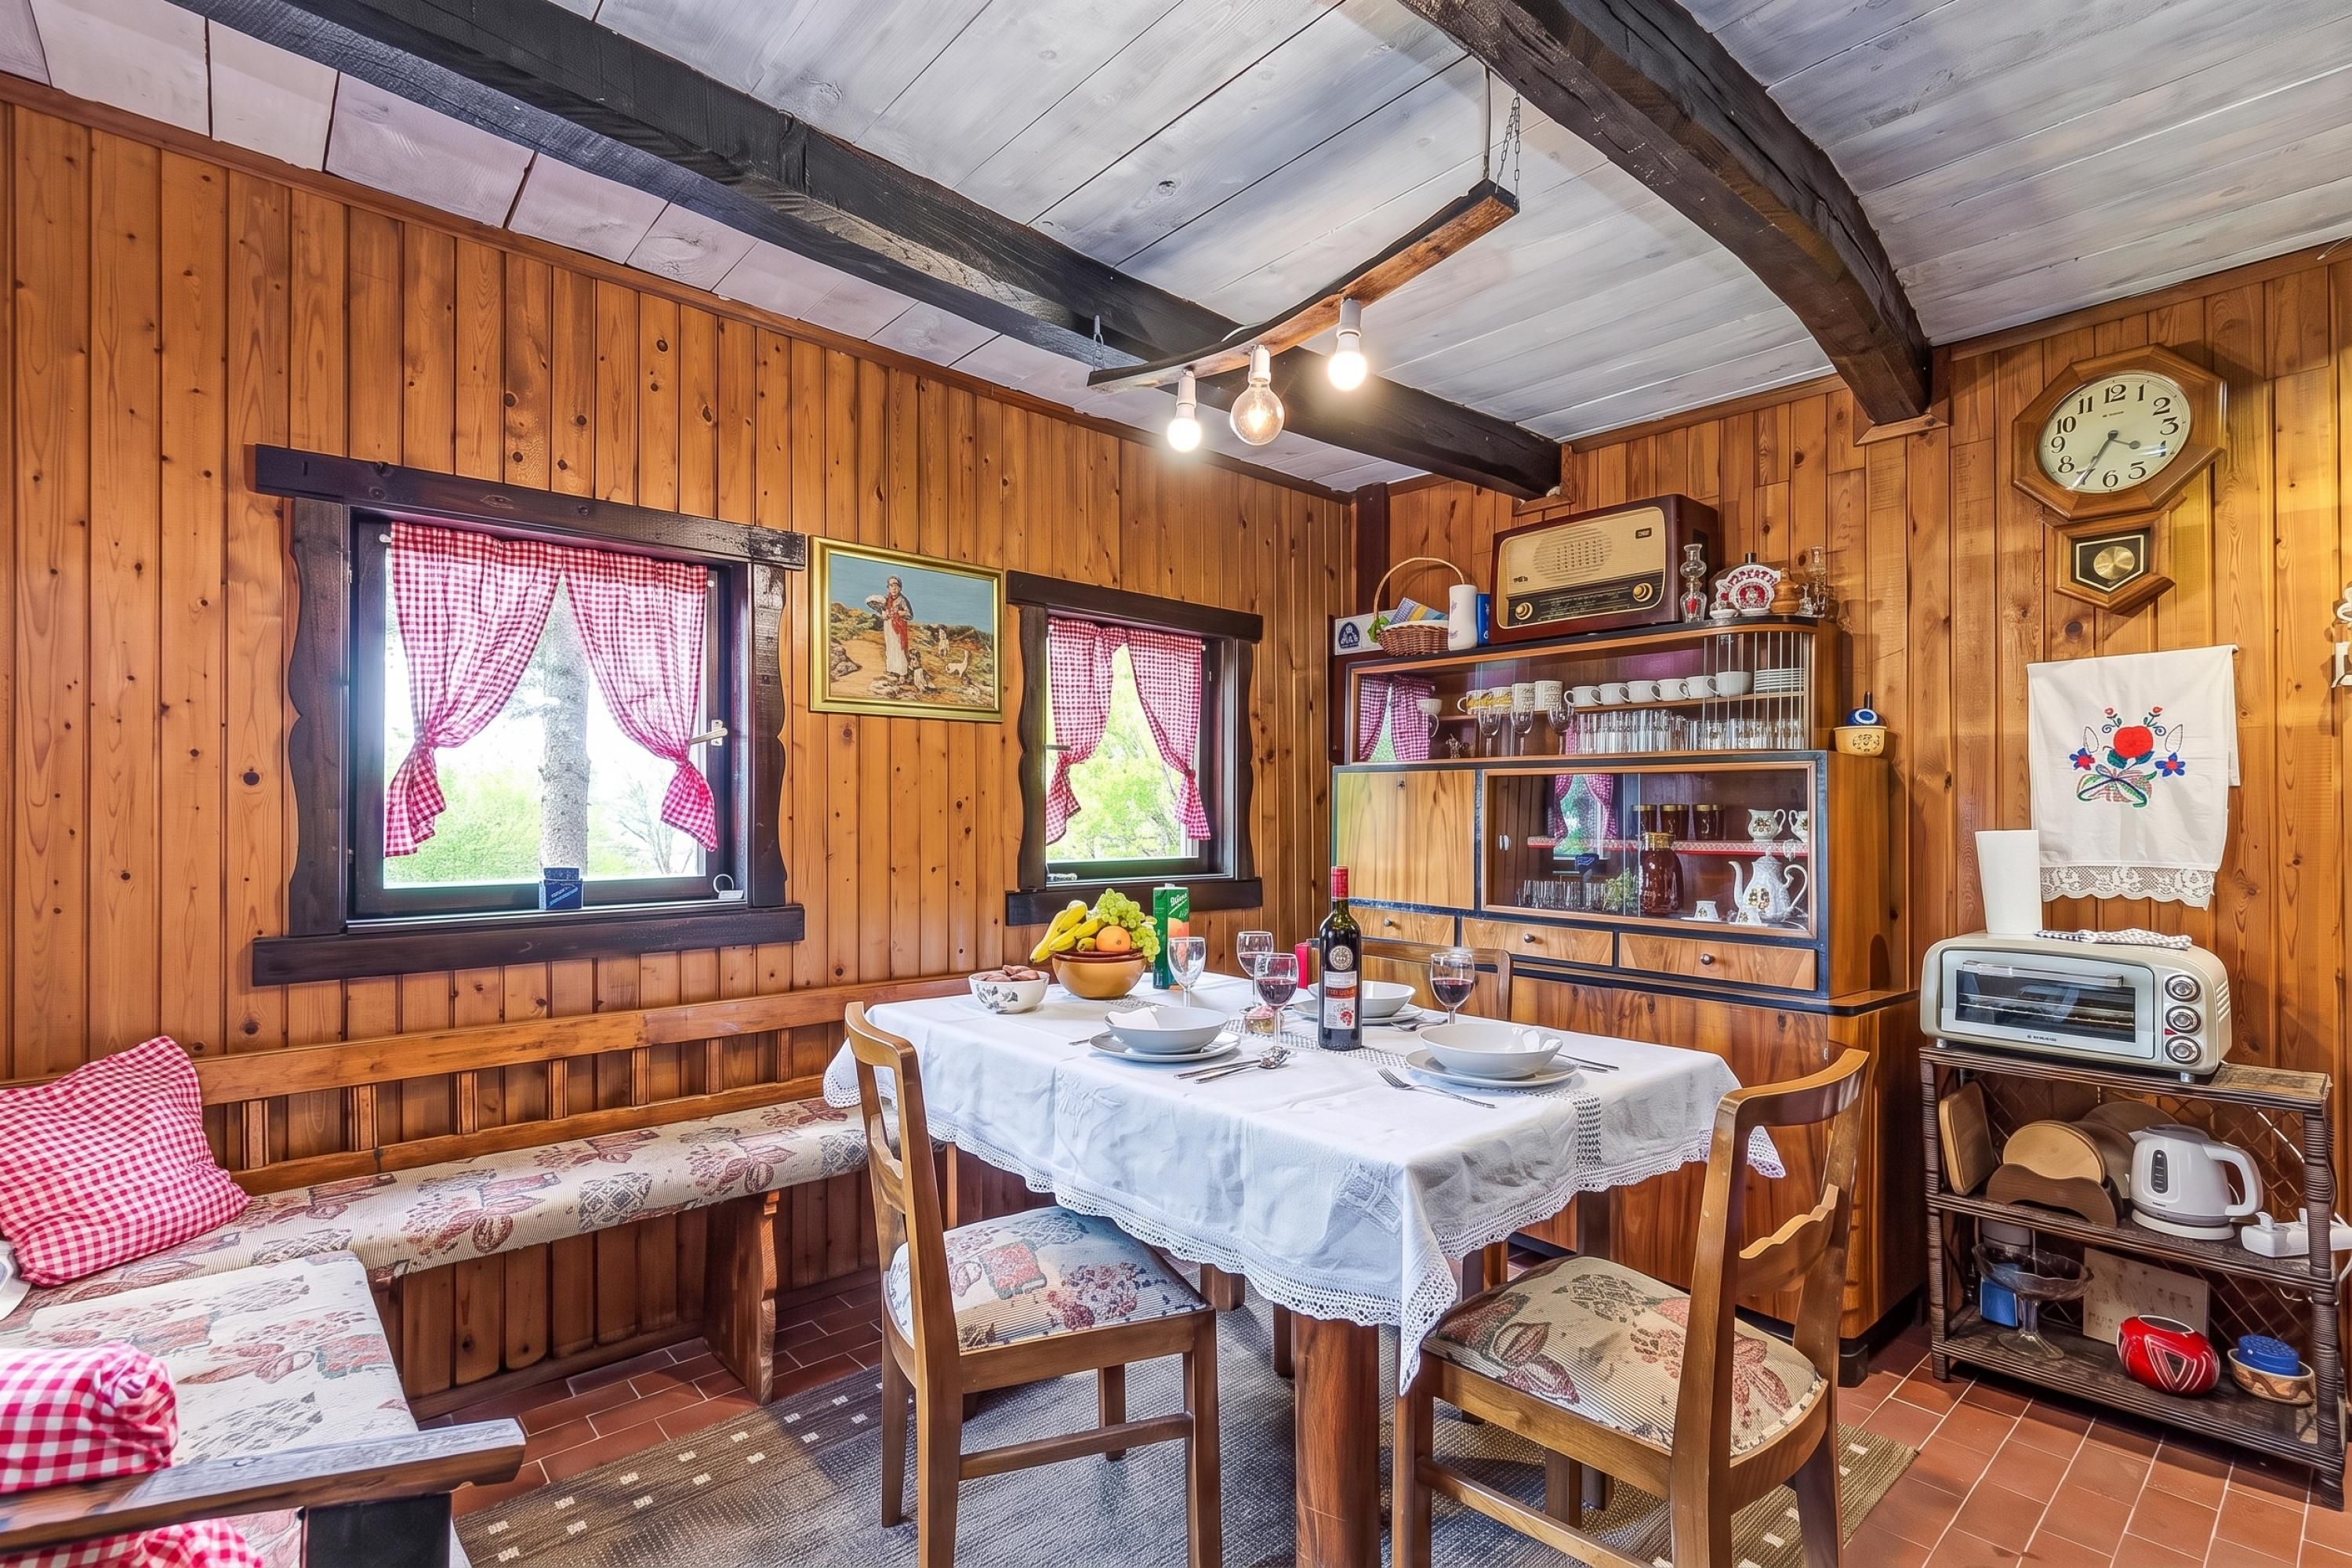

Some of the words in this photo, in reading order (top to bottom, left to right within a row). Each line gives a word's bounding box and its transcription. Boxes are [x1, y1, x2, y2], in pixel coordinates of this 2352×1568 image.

[2104, 384, 2126, 404] 12
[2137, 384, 2144, 402] 1
[2078, 396, 2093, 415] 11
[2152, 397, 2171, 416] 2
[2056, 416, 2076, 434] 10
[2160, 416, 2179, 435] 3
[2051, 436, 2066, 454] 9
[2057, 456, 2075, 474] 8
[2128, 461, 2147, 480] 5
[2102, 470, 2119, 488] 6
